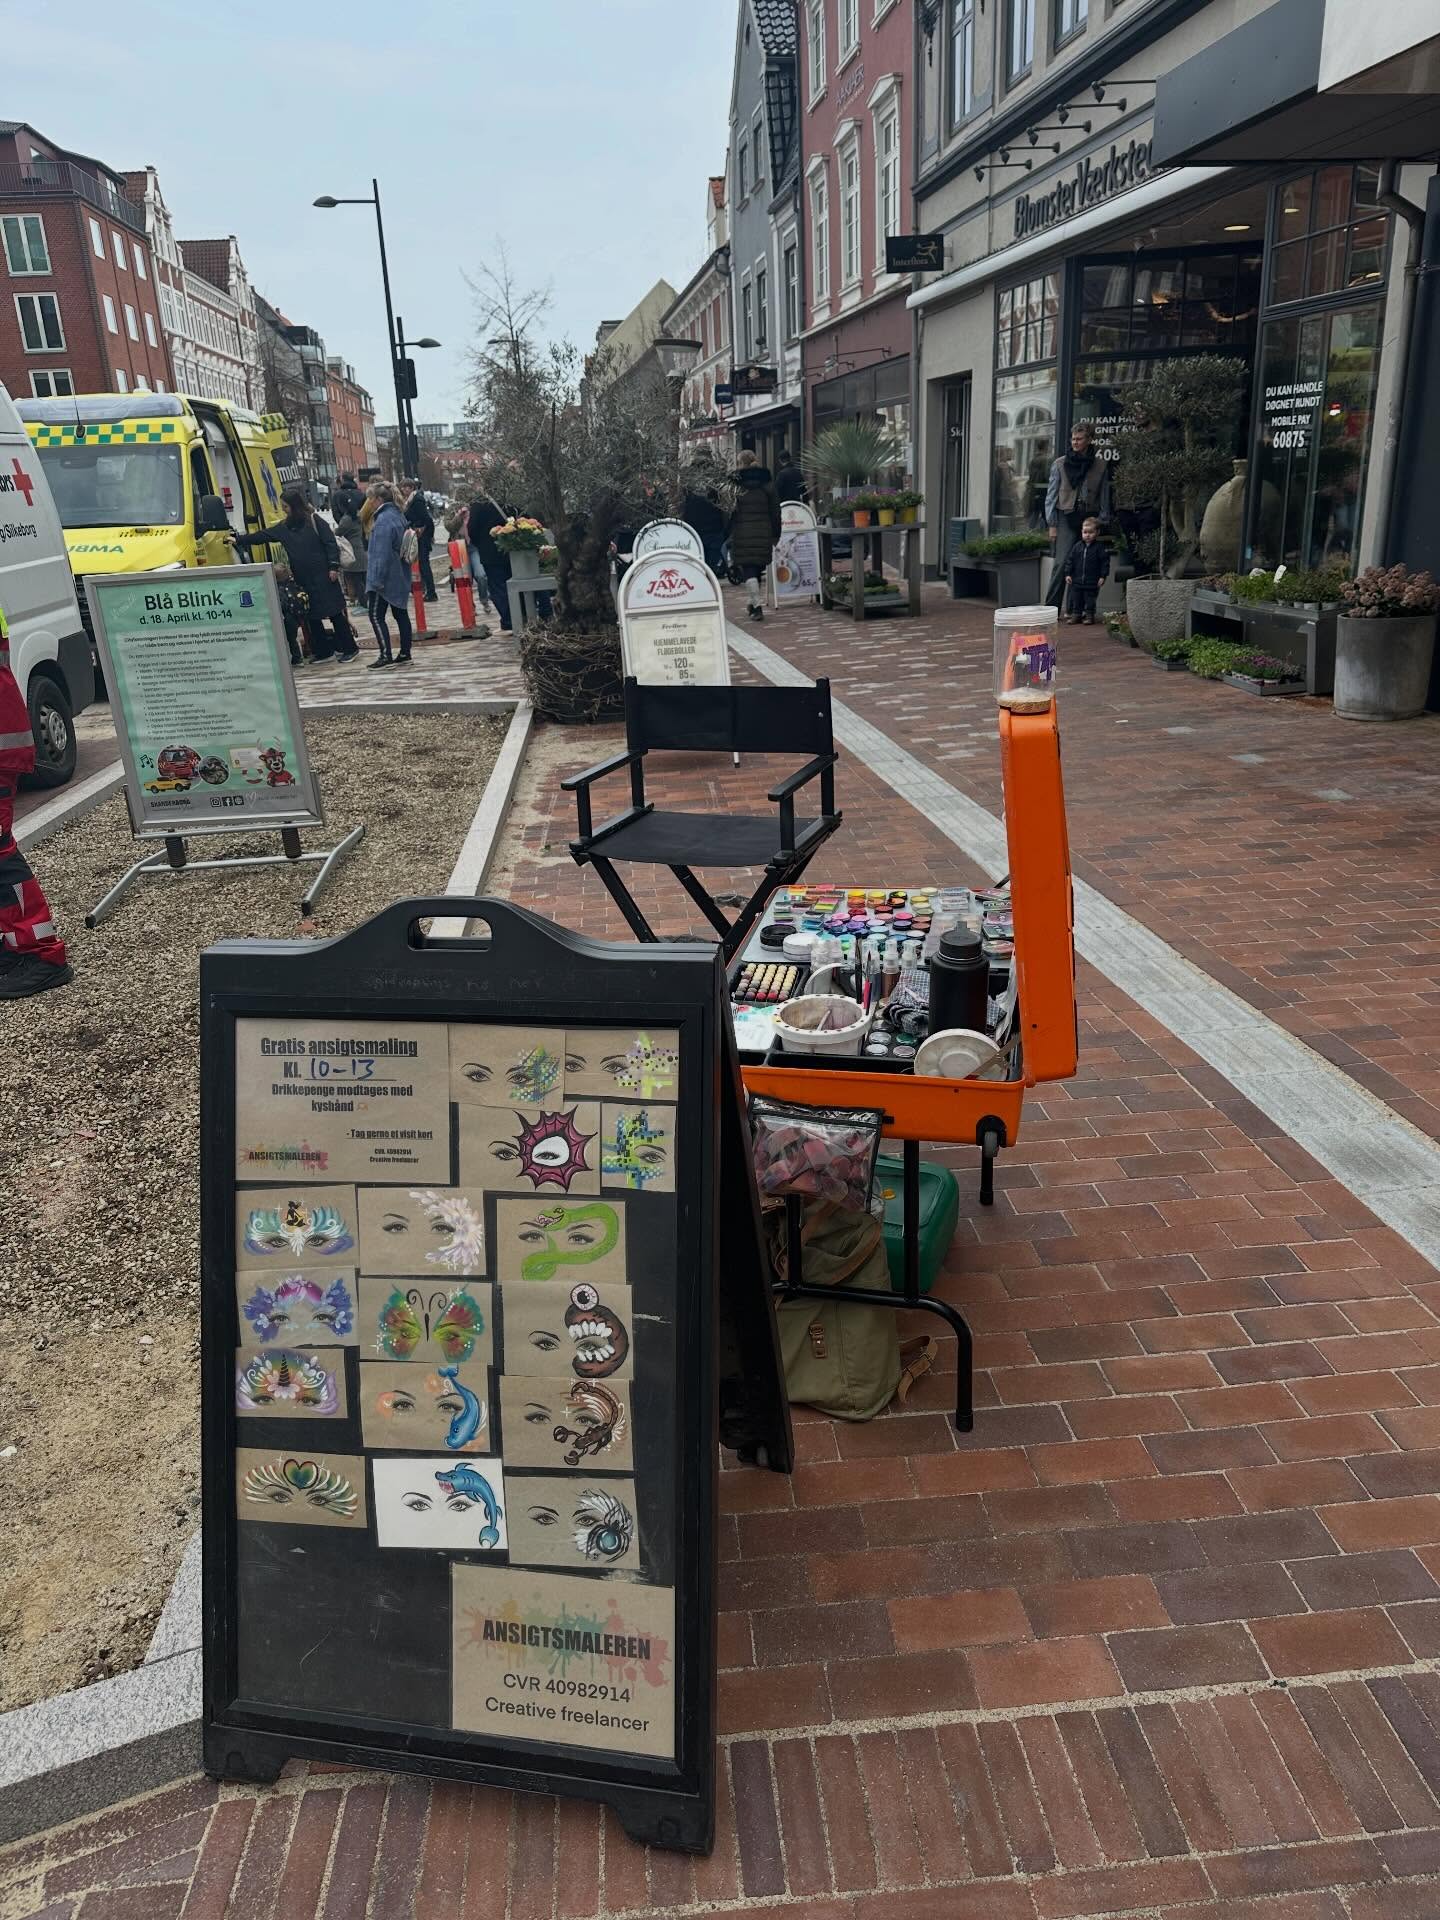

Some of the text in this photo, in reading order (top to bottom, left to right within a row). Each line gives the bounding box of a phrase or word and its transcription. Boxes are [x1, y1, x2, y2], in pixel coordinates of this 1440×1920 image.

[1265, 381, 1323, 397] DU KAN HANDLE
[1265, 396, 1321, 411] DØGNET RUNDT
[1096, 416, 1117, 424] KAN
[1271, 414, 1311, 427] MOBILE PAY
[1095, 425, 1121, 434] GNET
[1273, 430, 1305, 449] 60875
[1095, 448, 1120, 461] 608
[0, 474, 14, 492] ors
[0, 523, 37, 543] g/Silkeborg
[646, 578, 694, 594] JAVA
[144, 592, 173, 610] Blå
[177, 590, 224, 608] Blink
[139, 609, 232, 625] d. 18. April kl. 10-14
[674, 657, 688, 669] 120
[260, 1037, 418, 1056] Gratis ansigtsmaling
[283, 1058, 375, 1080] Kl. 10-13
[271, 1083, 413, 1097] Drikkepenge modtages med
[311, 1099, 354, 1112] kyshånd
[351, 1129, 366, 1138] Tag
[366, 1130, 389, 1139] gerne
[391, 1130, 399, 1138] et
[399, 1130, 417, 1138] visit
[417, 1130, 433, 1139] kort
[248, 1151, 321, 1161] ANSIGTSMALEREN
[482, 1619, 651, 1661] ANSIGTSMALEREN
[503, 1673, 631, 1703] CVR 40982914
[485, 1696, 650, 1732] Creative freelancer
